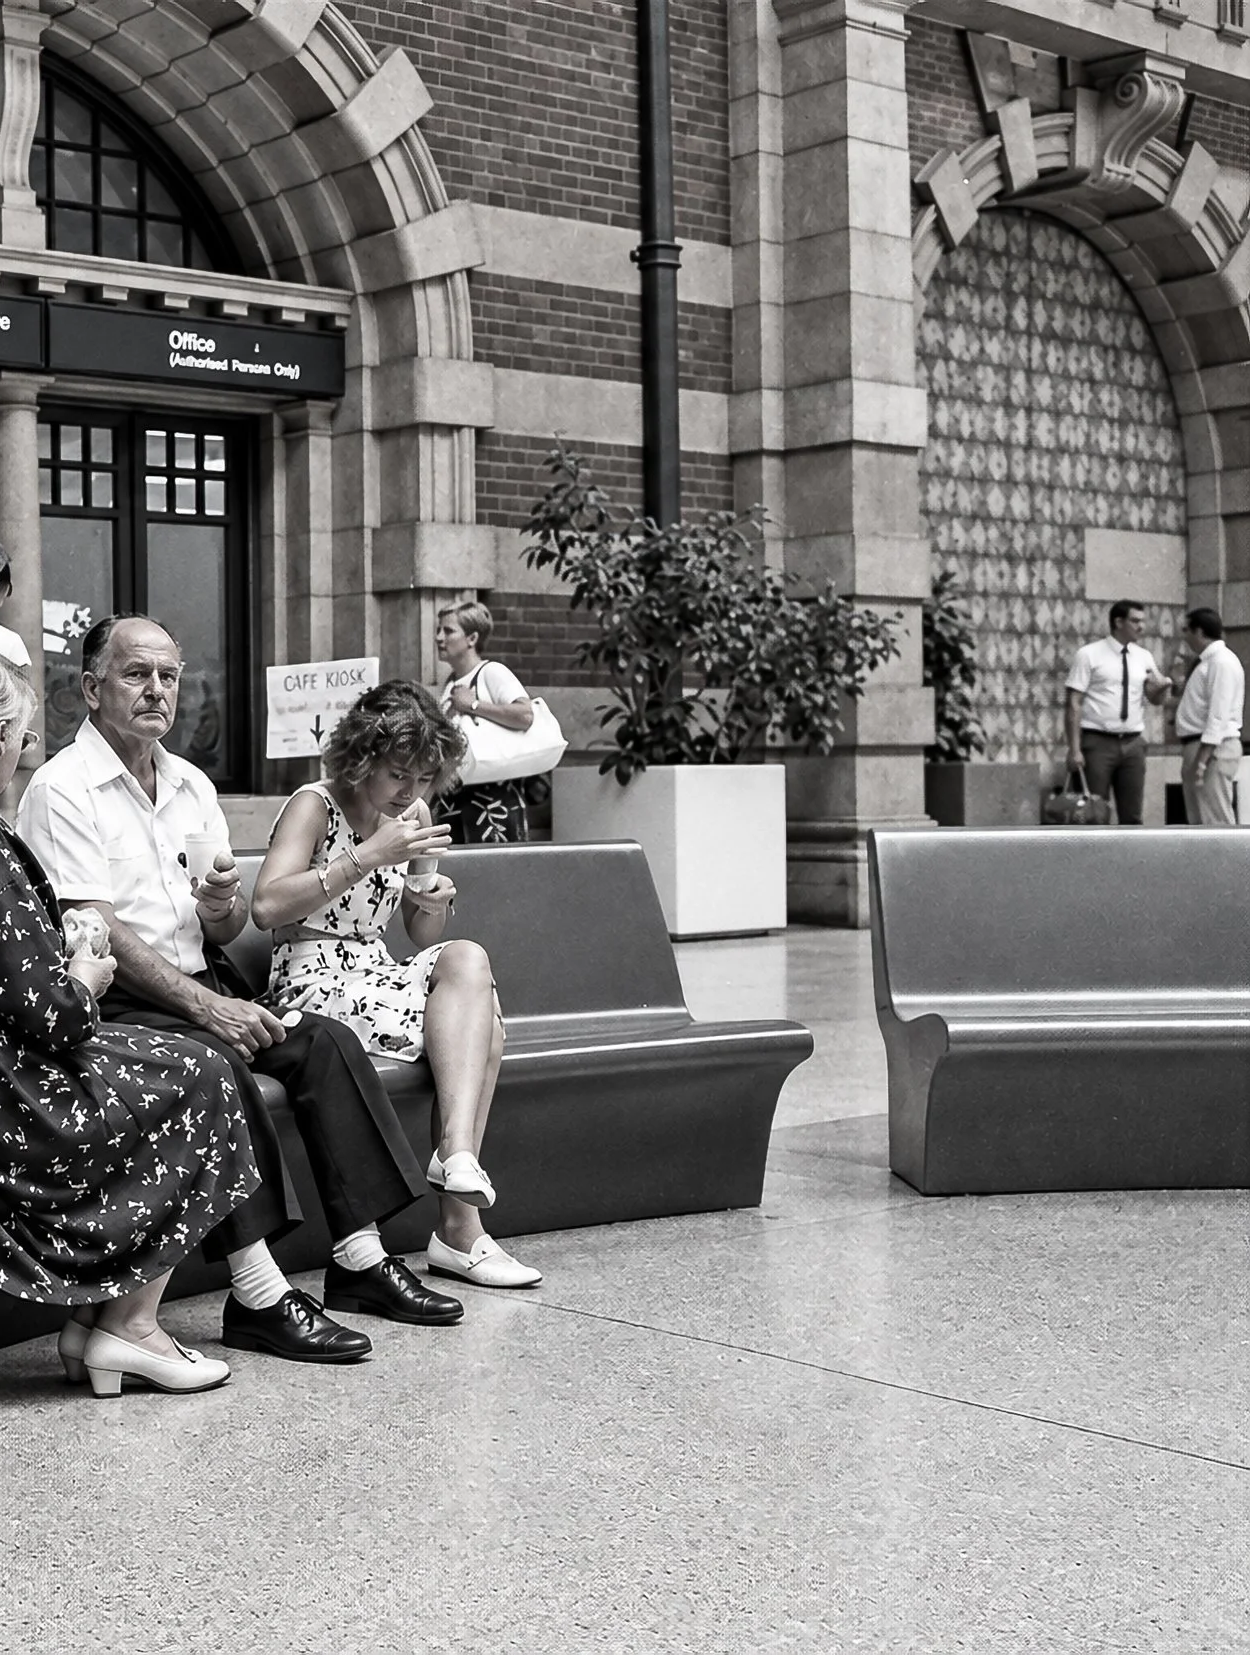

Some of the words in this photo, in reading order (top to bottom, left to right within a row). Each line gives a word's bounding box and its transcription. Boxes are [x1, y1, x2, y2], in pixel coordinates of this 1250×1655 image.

[168, 329, 216, 353] Office
[168, 351, 229, 371] (Authorised
[273, 362, 301, 380] Only)
[283, 673, 318, 692] CAFE
[326, 667, 367, 687] KIOSK
